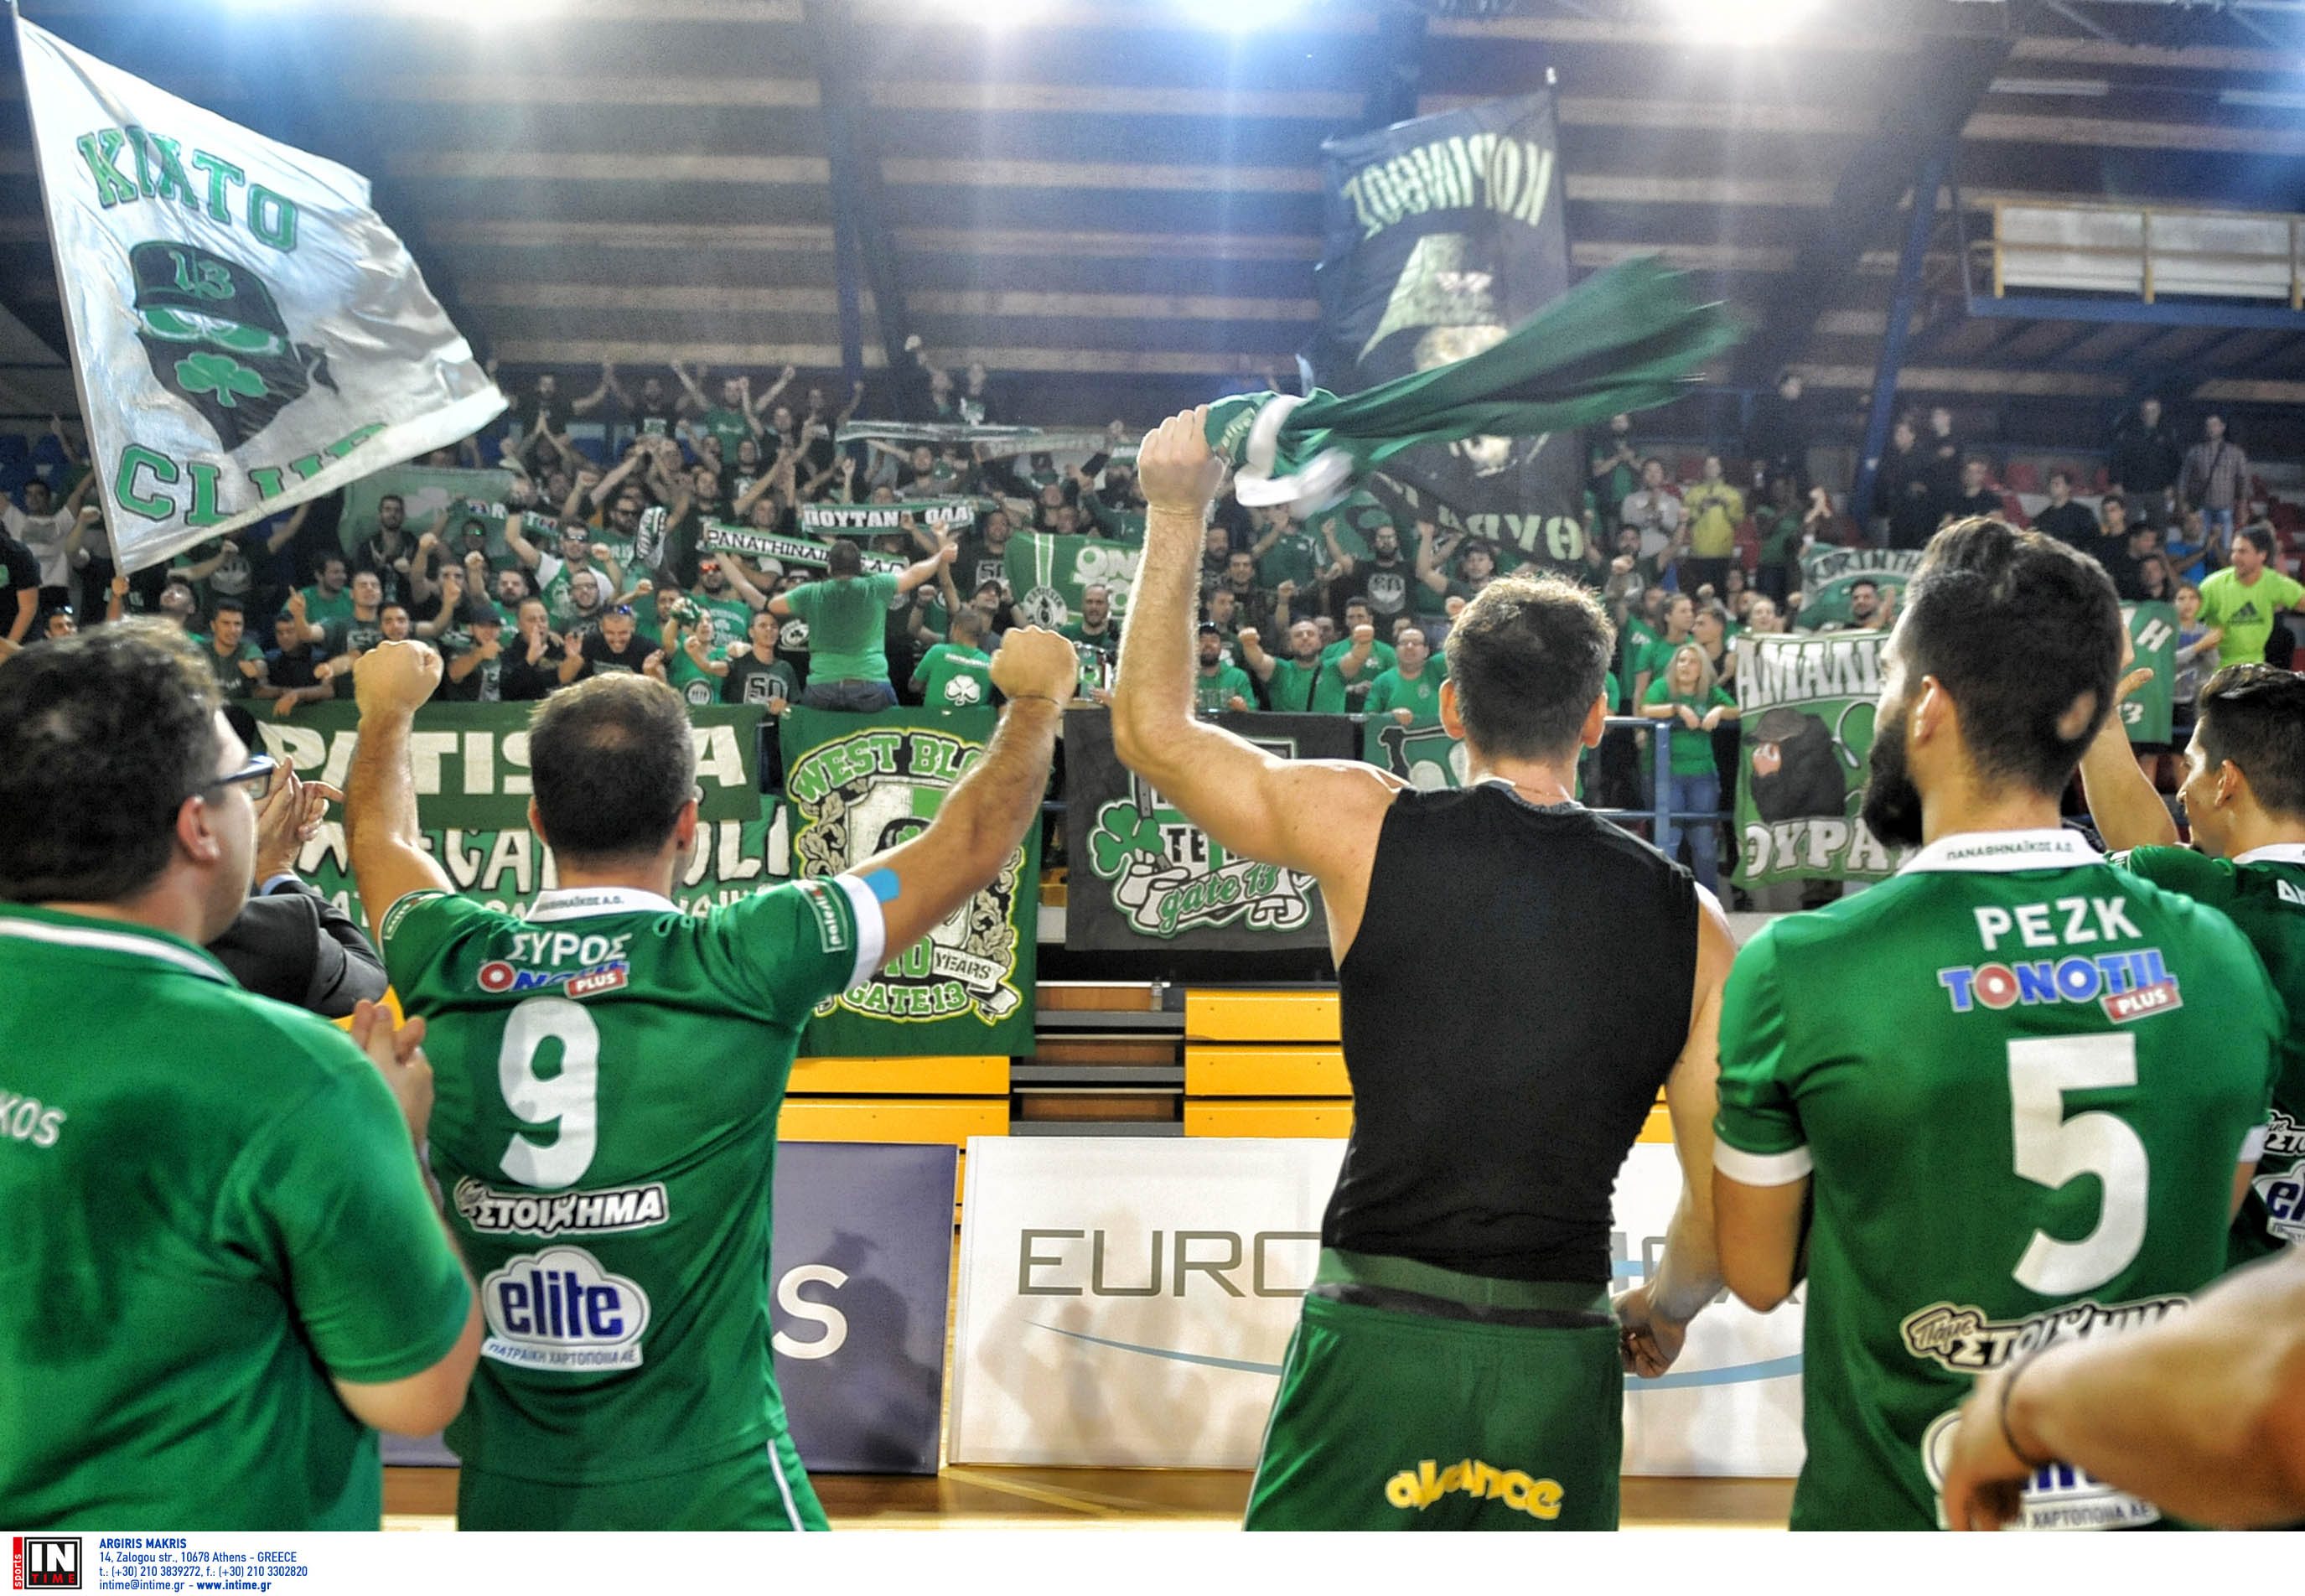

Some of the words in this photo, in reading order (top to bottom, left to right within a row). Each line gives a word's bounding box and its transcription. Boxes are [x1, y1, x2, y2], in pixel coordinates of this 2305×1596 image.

[76, 125, 298, 254] KIATO
[805, 508, 910, 527] ΠΟΥΤΑΝ
[790, 735, 899, 802] WEST
[505, 931, 633, 966] ΣΥΡΟΣ
[935, 951, 992, 981] YEARS
[575, 971, 619, 992] PLUS
[1939, 949, 2178, 1012] TONOTIL
[2118, 987, 2169, 1016] PLUS
[498, 996, 600, 1189] 9
[2007, 1030, 2150, 1296] 5
[499, 1270, 624, 1337] elite
